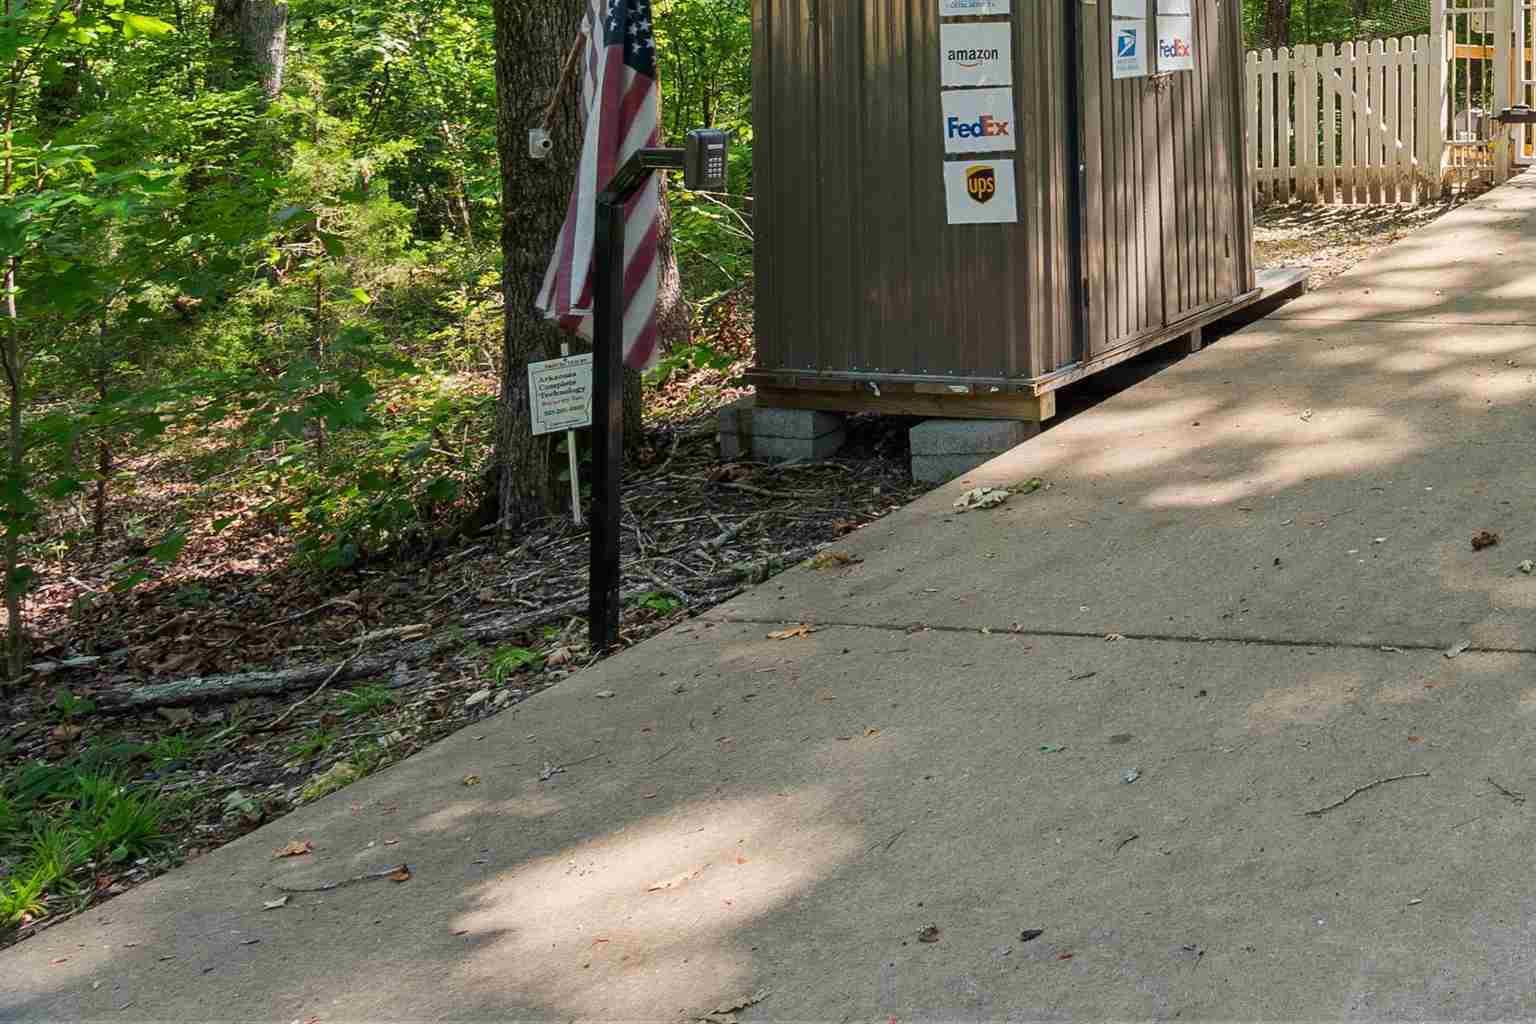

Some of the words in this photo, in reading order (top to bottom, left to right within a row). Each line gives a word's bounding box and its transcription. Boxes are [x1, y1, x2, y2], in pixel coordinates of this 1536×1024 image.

[947, 48, 999, 62] amazon
[1160, 38, 1190, 58] FedEx
[947, 113, 1009, 139] FedEx
[968, 177, 995, 199] ups
